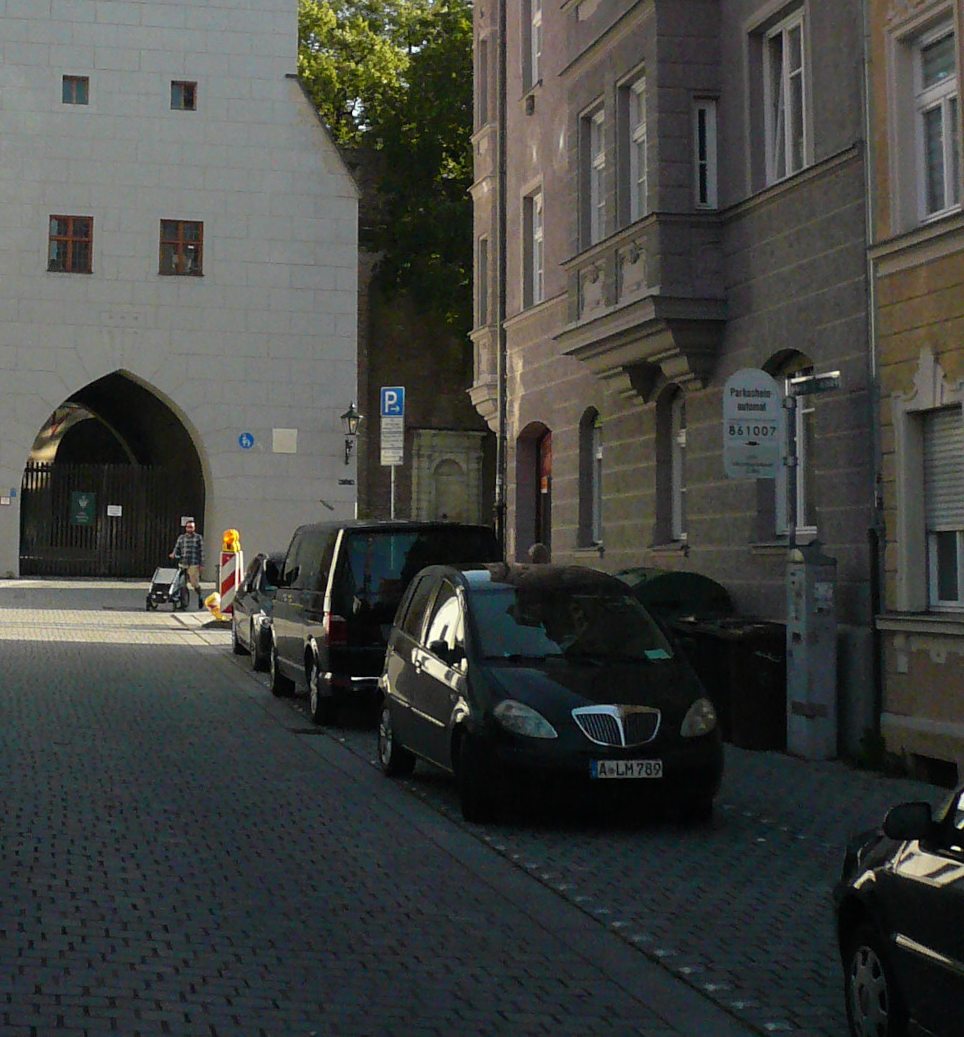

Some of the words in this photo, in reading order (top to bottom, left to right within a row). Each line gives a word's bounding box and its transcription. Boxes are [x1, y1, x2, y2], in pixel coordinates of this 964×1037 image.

[385, 391, 397, 413] P
[728, 425, 776, 436] 861007
[599, 763, 607, 775] A
[616, 763, 634, 776] LM
[637, 763, 661, 776] 789
